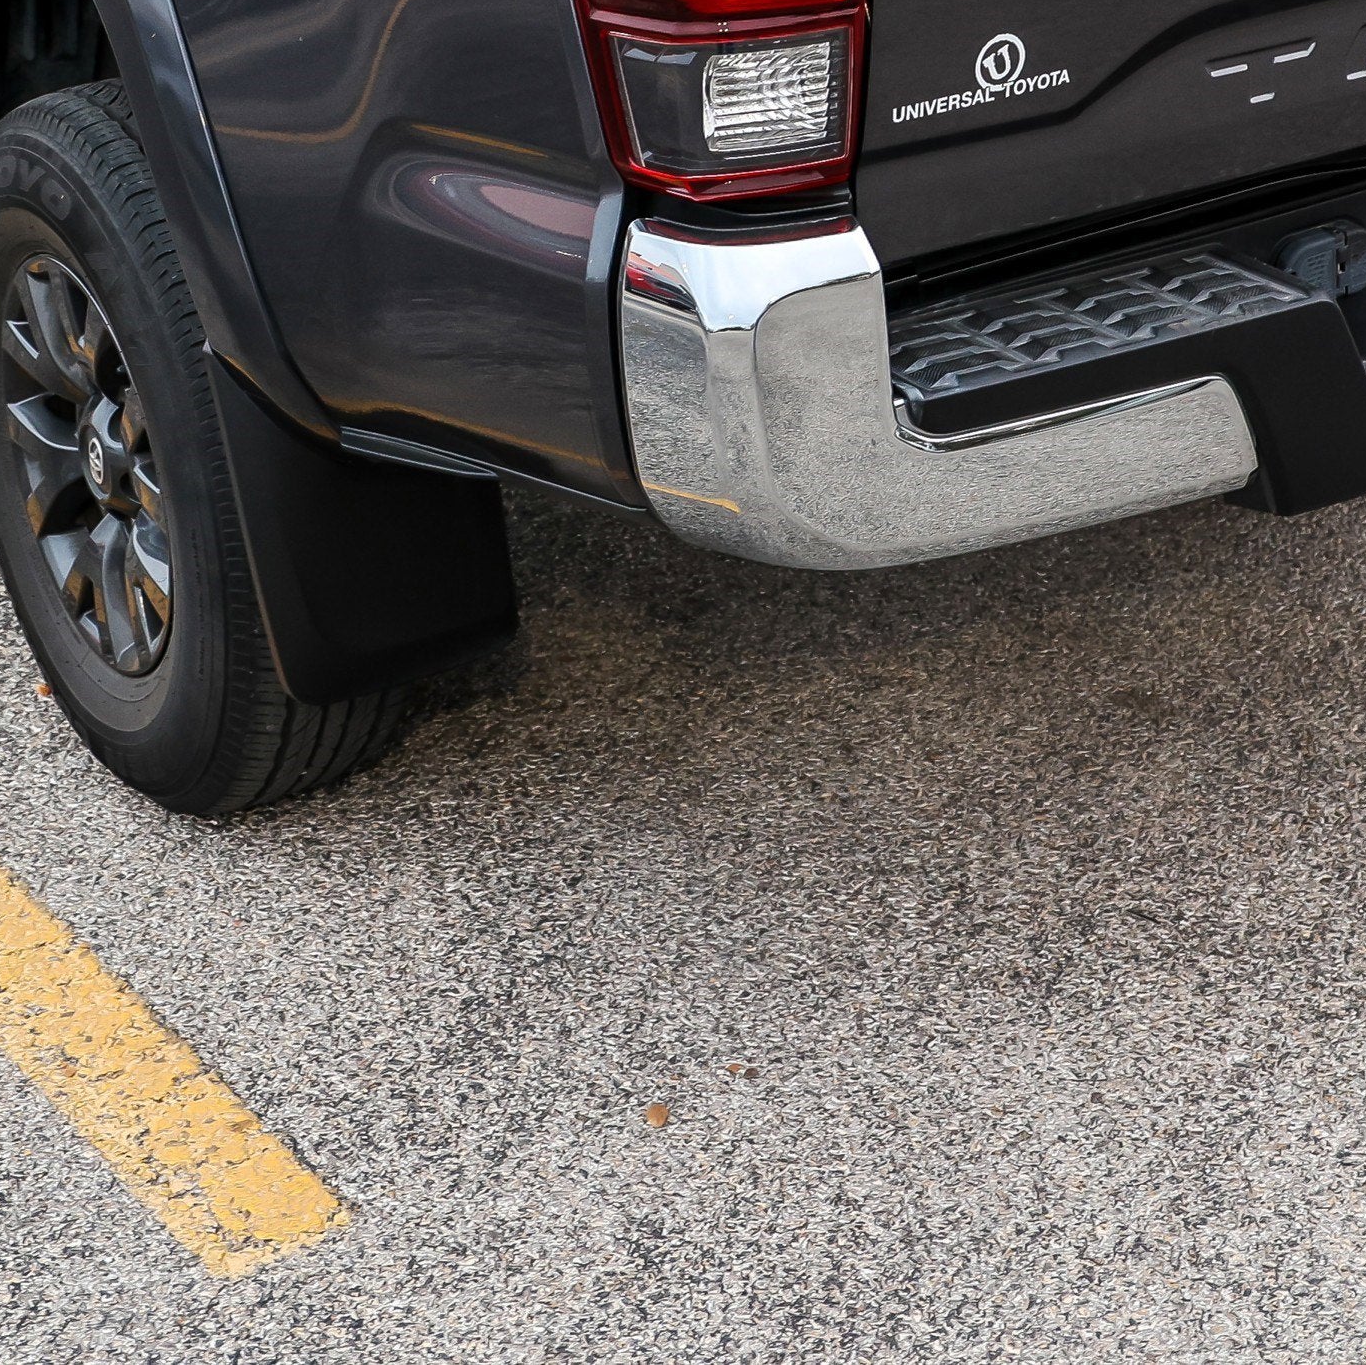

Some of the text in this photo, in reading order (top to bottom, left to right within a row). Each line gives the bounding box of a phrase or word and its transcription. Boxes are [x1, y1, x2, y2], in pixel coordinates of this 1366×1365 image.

[982, 43, 1012, 81] U
[892, 68, 1071, 124] UNIVERSAL TOYOTA
